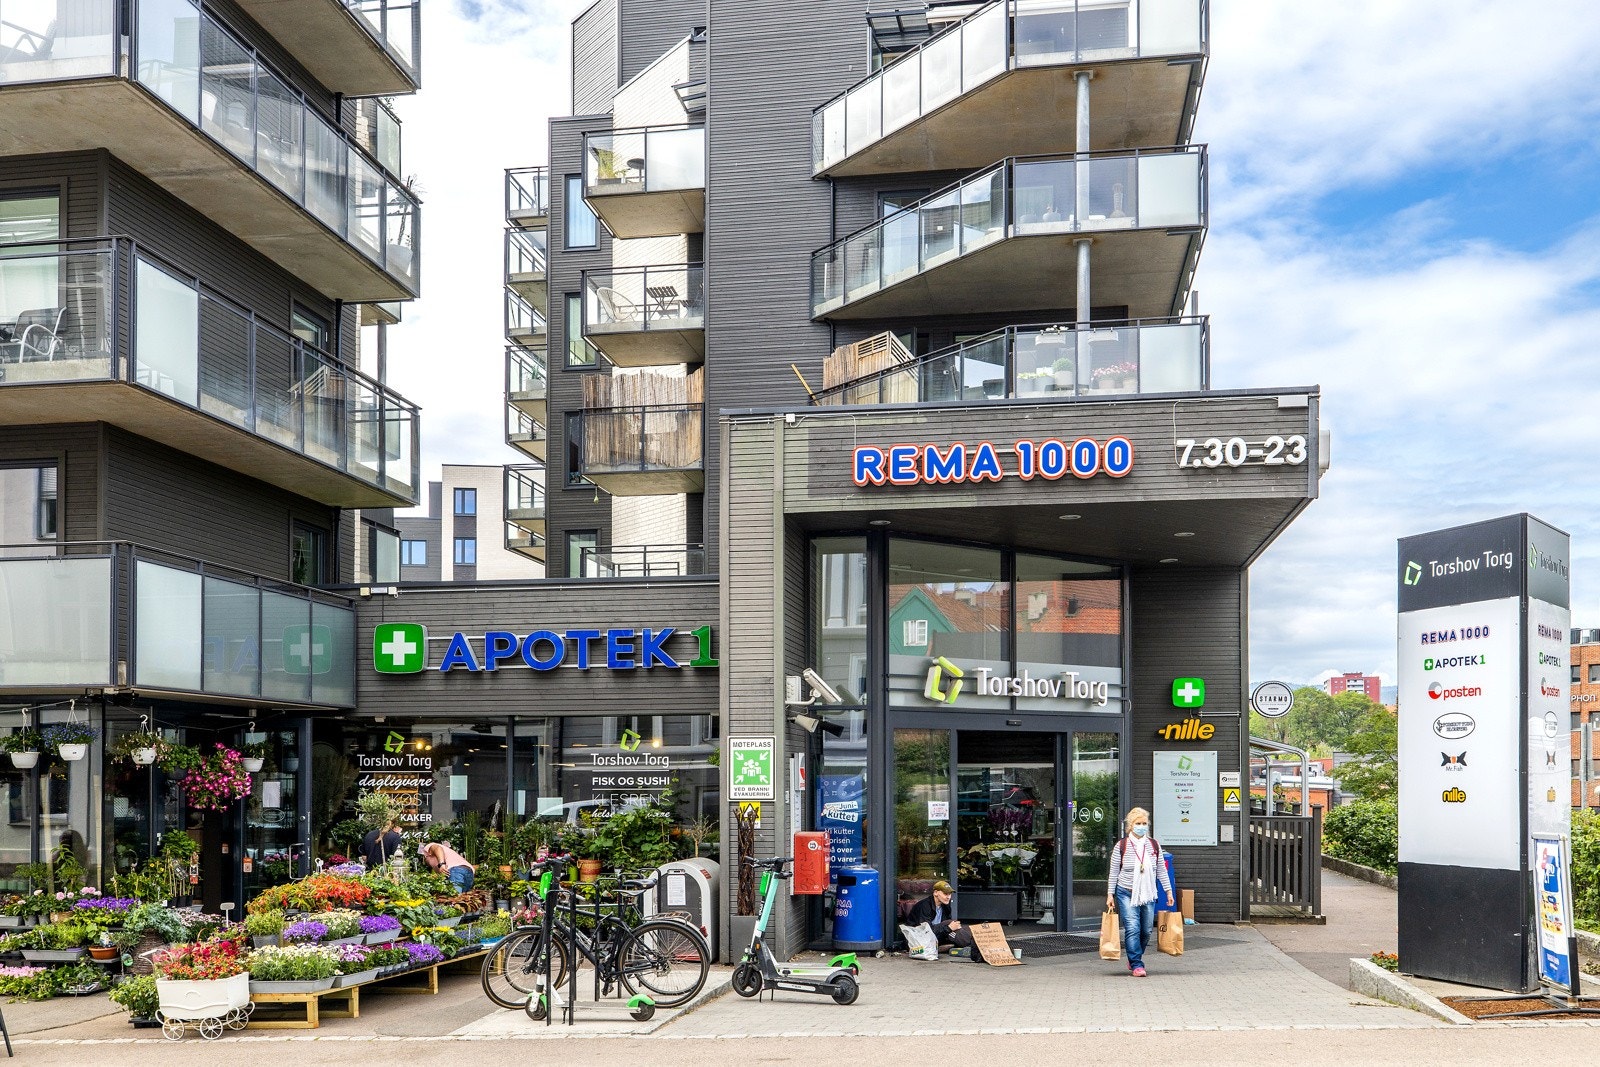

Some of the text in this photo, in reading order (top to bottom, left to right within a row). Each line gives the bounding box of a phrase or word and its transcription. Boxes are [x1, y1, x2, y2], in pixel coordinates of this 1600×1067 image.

[853, 436, 1134, 487] REMA 1000
[1429, 551, 1513, 577] Torshov Torg
[1421, 625, 1491, 645] REMA 1000
[439, 625, 720, 672] APOTEK 1
[1435, 654, 1486, 669] APOTEK 1
[973, 667, 1109, 706] Torshov Torg
[1443, 686, 1482, 700] posten
[356, 753, 432, 769] Torshov Torg
[590, 752, 670, 768] Torshov Torg
[358, 774, 433, 790] dagligvare
[592, 776, 670, 786] FISK OG SUSHI
[1442, 787, 1466, 803] nille
[400, 813, 432, 822] KAKER
[827, 811, 856, 822] kuttet
